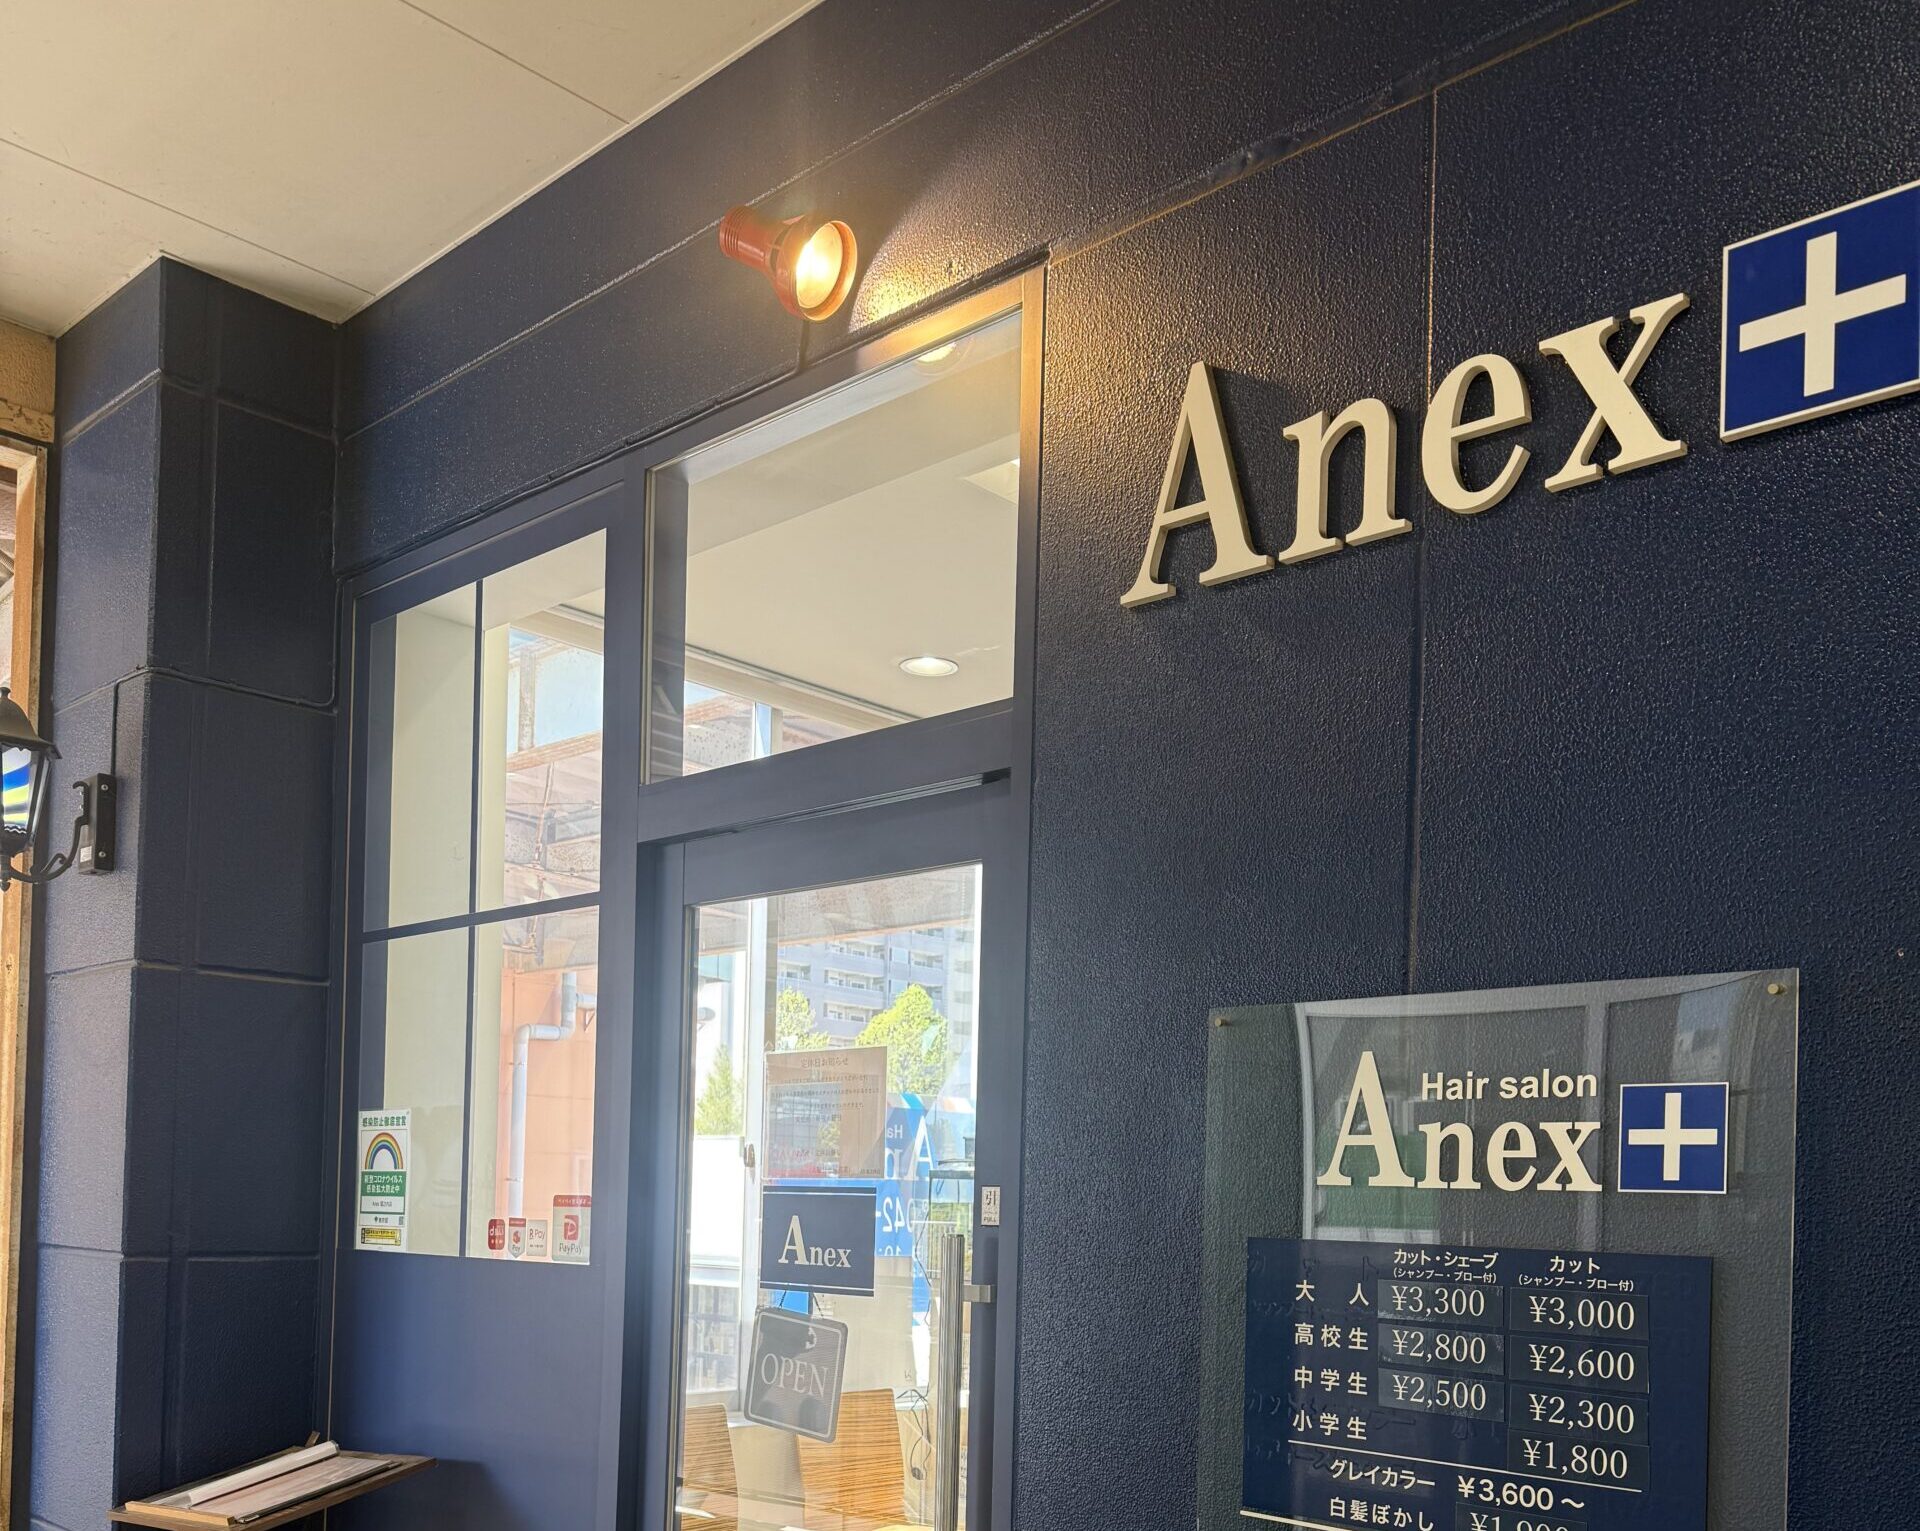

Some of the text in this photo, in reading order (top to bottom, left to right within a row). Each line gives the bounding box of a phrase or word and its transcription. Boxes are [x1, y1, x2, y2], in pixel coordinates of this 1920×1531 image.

[1120, 292, 1691, 609] Anex
[1421, 1068, 1597, 1101] Hair salon
[1316, 1049, 1603, 1192] Anex
[559, 1242, 582, 1255] PayPay
[778, 1214, 852, 1268] Anex
[1393, 1248, 1601, 1273] カット・シェーブ カット
[1392, 1285, 1486, 1317] ¥3,300
[1528, 1295, 1635, 1331] ¥3,000
[1294, 1321, 1635, 1381] 高校生 ¥2,800 ¥2,600
[761, 1352, 829, 1398] OPEN
[1293, 1365, 1635, 1434] 中学生 ¥2,500 ¥2,300
[1292, 1410, 1629, 1479] 小学生 ¥1,800
[1329, 1458, 1436, 1491] グレイカラー
[1329, 1496, 1435, 1531] 白髪ぼかし
